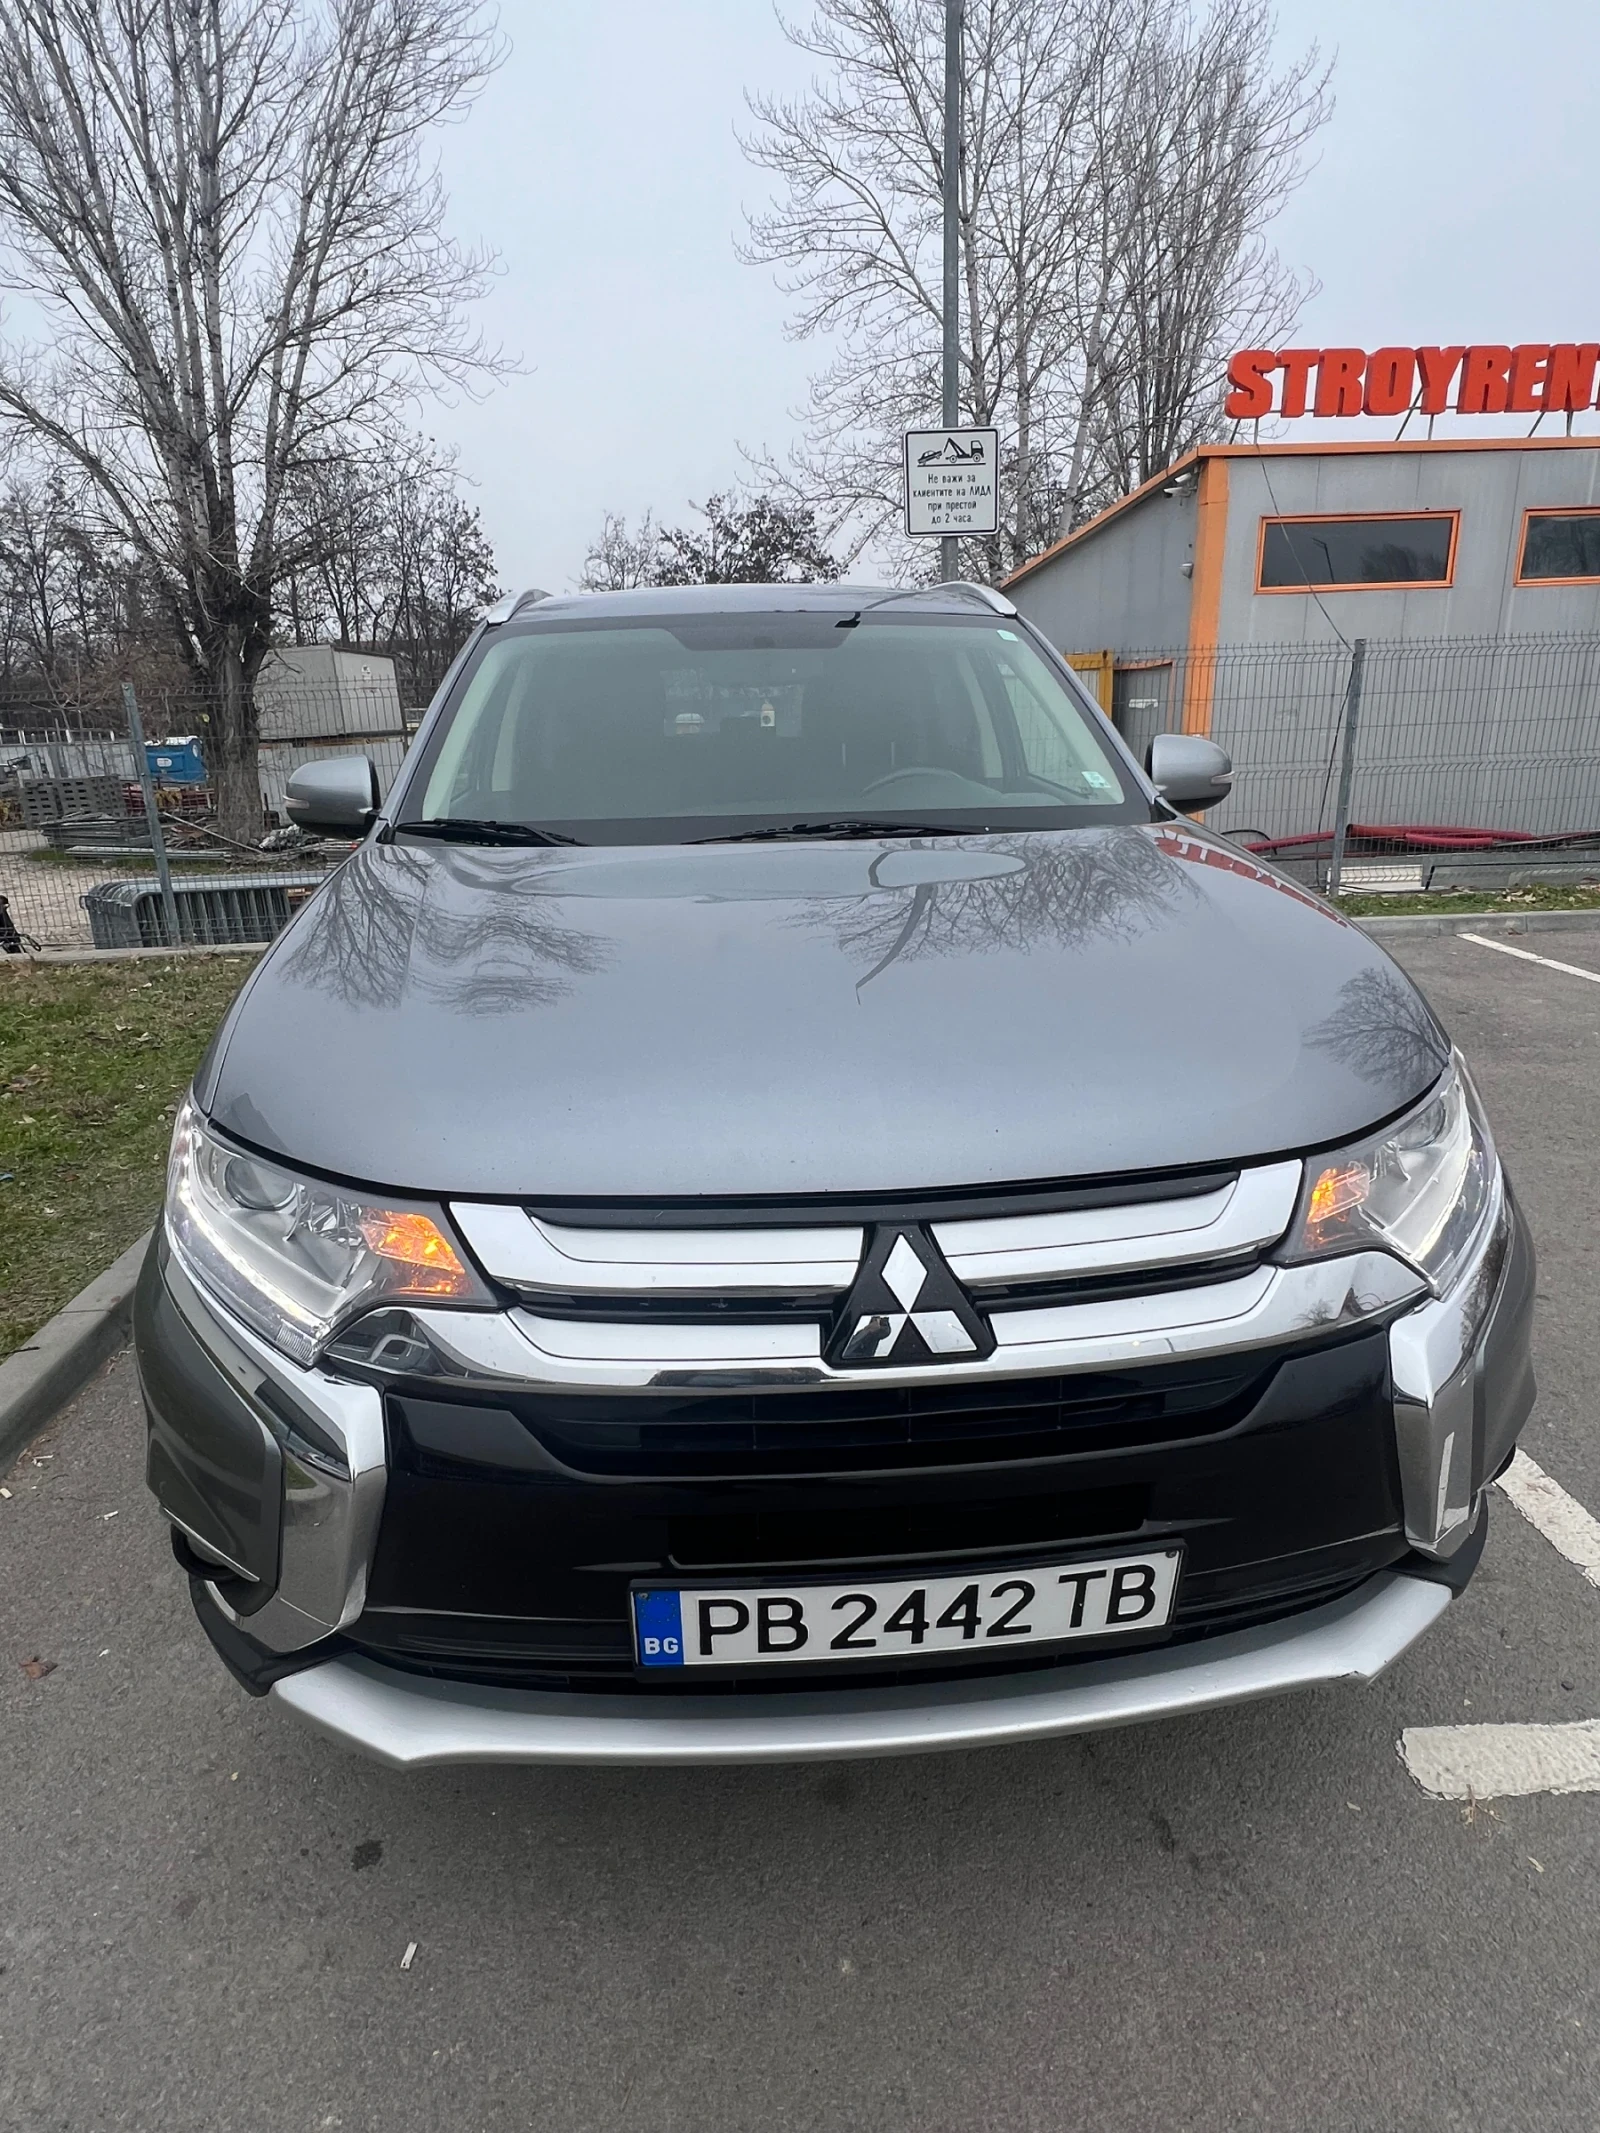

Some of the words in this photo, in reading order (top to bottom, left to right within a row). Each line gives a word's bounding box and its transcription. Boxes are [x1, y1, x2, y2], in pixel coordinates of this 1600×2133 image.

[1224, 343, 1600, 419] STROYREN
[928, 474, 939, 484] Не
[942, 475, 963, 483] важи
[966, 474, 976, 483] за
[913, 489, 953, 497] клиентите
[956, 488, 966, 497] на
[970, 485, 991, 496] ЛИДЛ
[928, 503, 941, 512] при
[946, 501, 976, 512] престой
[931, 516, 941, 524] до
[945, 513, 950, 523] 2
[698, 1597, 809, 1656] PB
[829, 1580, 1036, 1651] 2442
[1057, 1564, 1157, 1629] TB
[644, 1637, 679, 1655] BG
